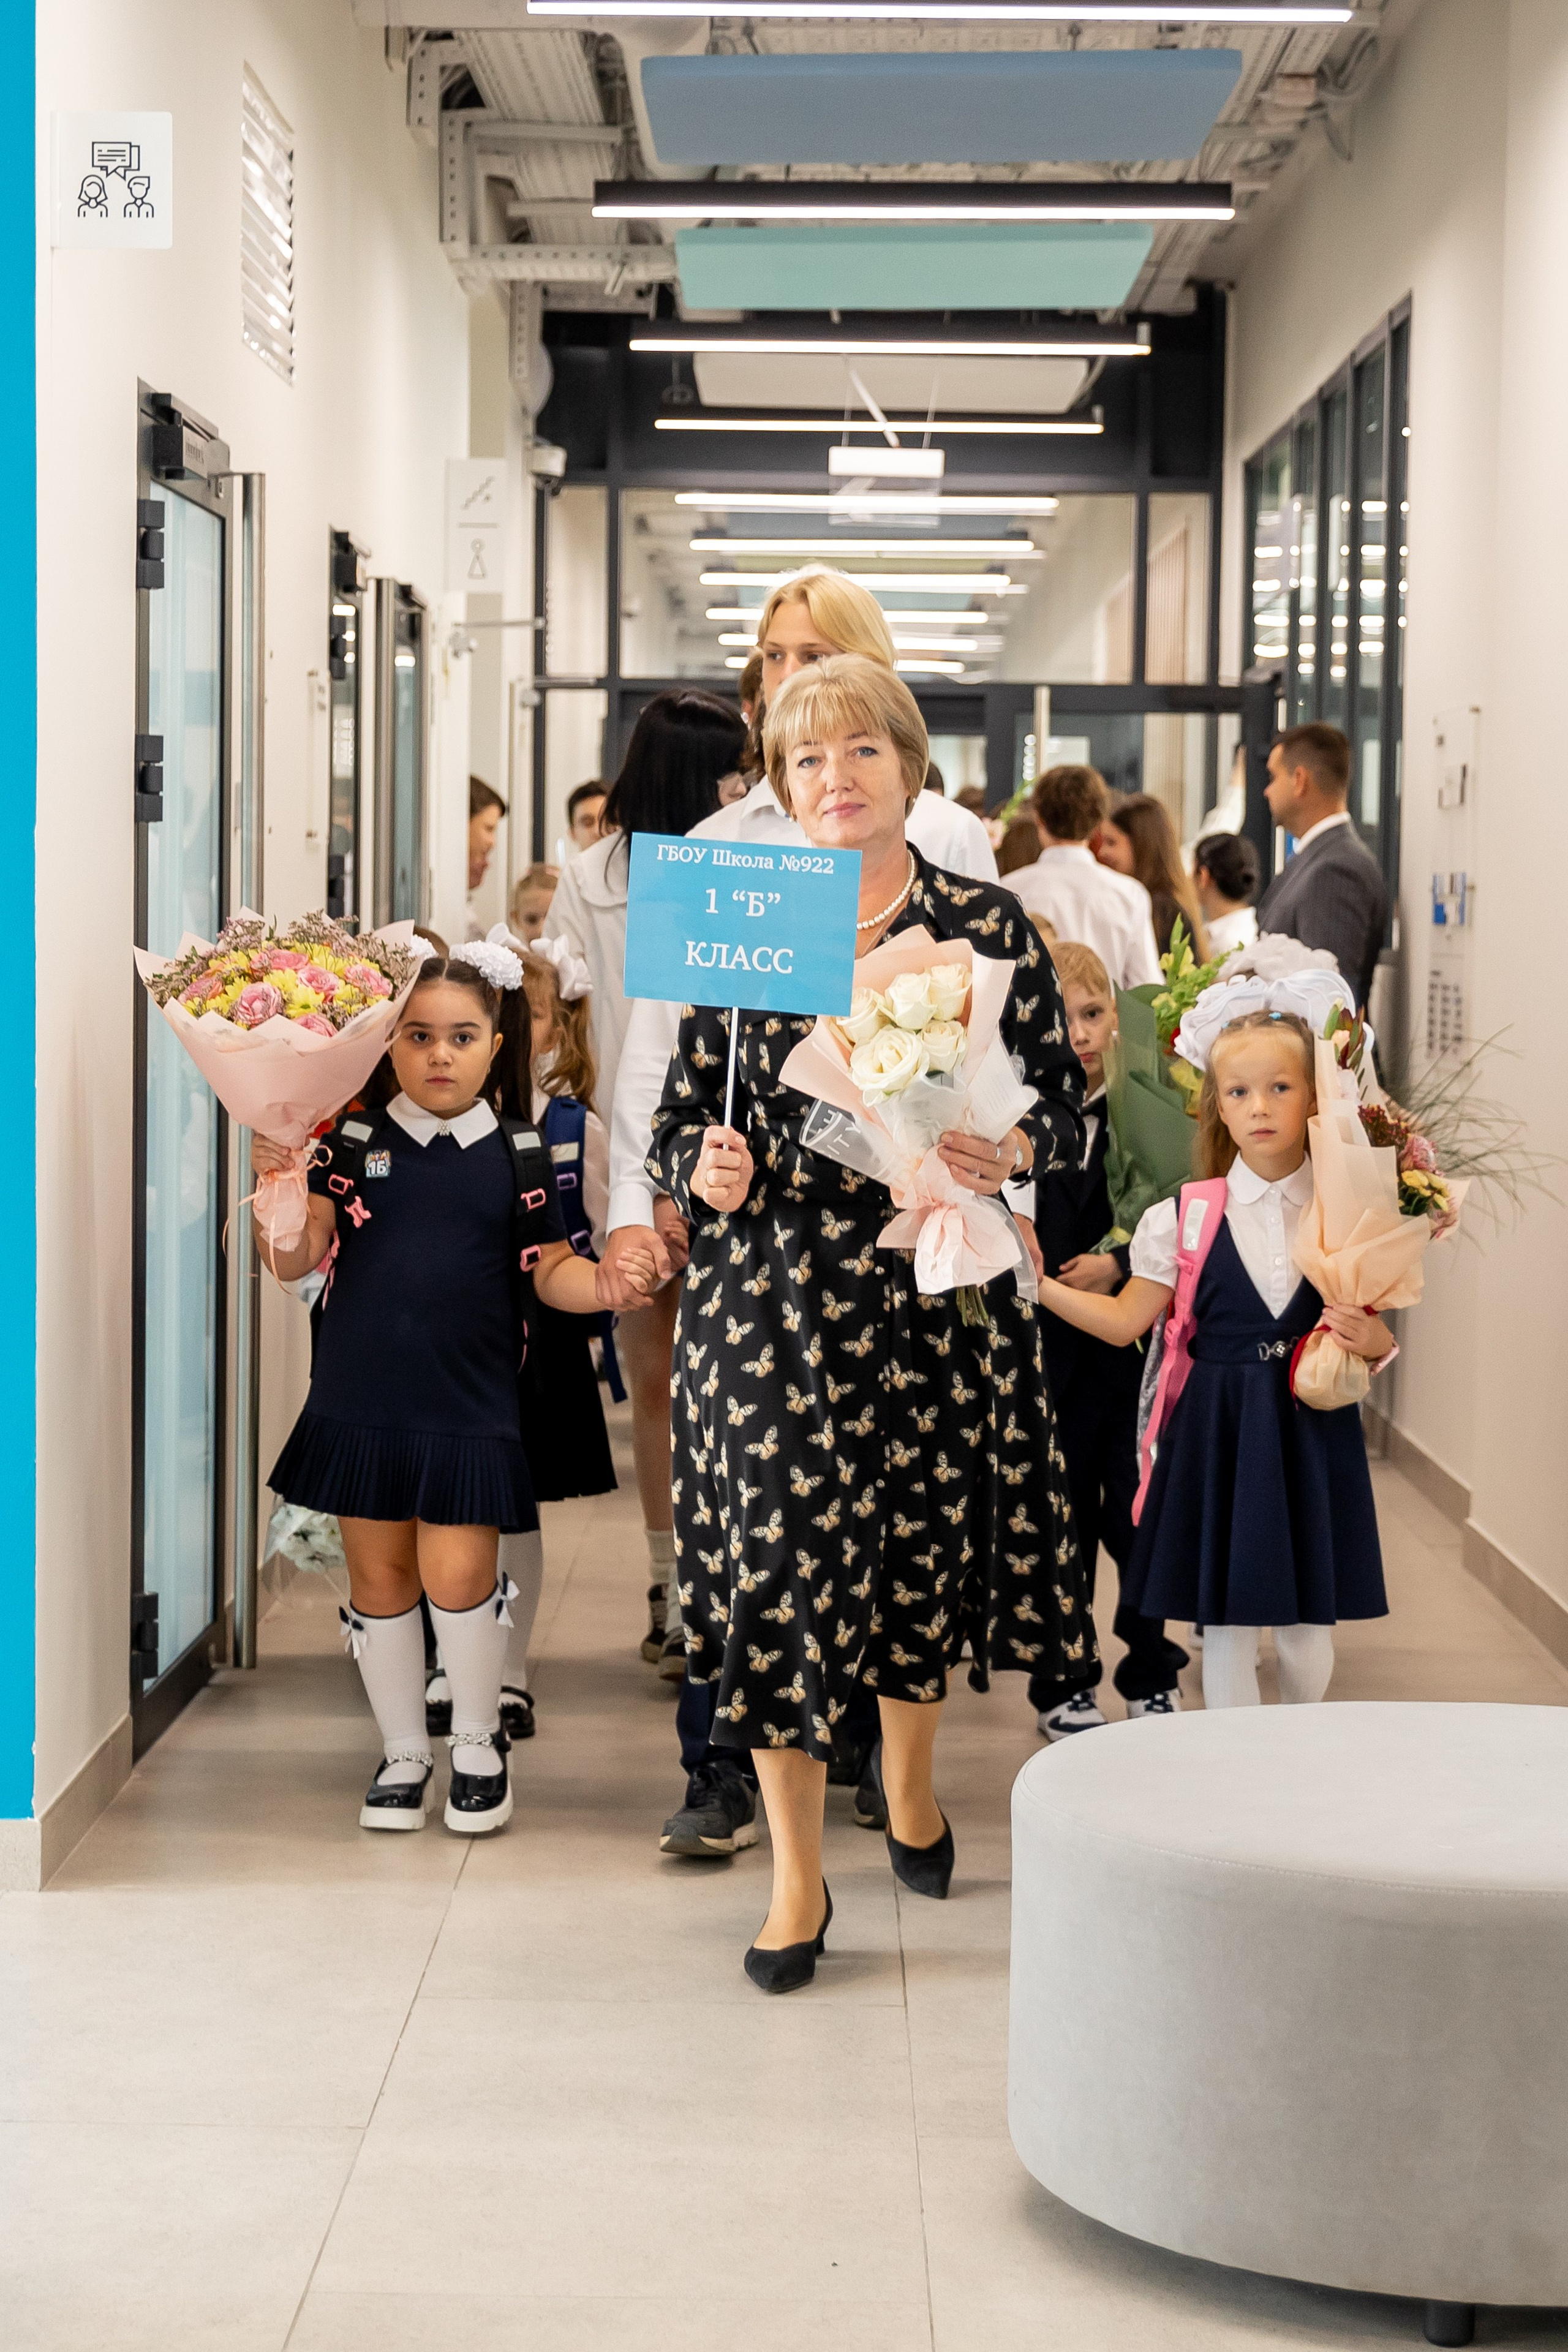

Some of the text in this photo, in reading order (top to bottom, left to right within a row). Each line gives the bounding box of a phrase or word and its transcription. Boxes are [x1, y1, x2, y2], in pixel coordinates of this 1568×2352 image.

[657, 845, 834, 874] ГБОУ Школа №922
[706, 888, 718, 914] 1
[685, 941, 793, 974] КЛАСС
[817, 1121, 861, 1158] ITY
